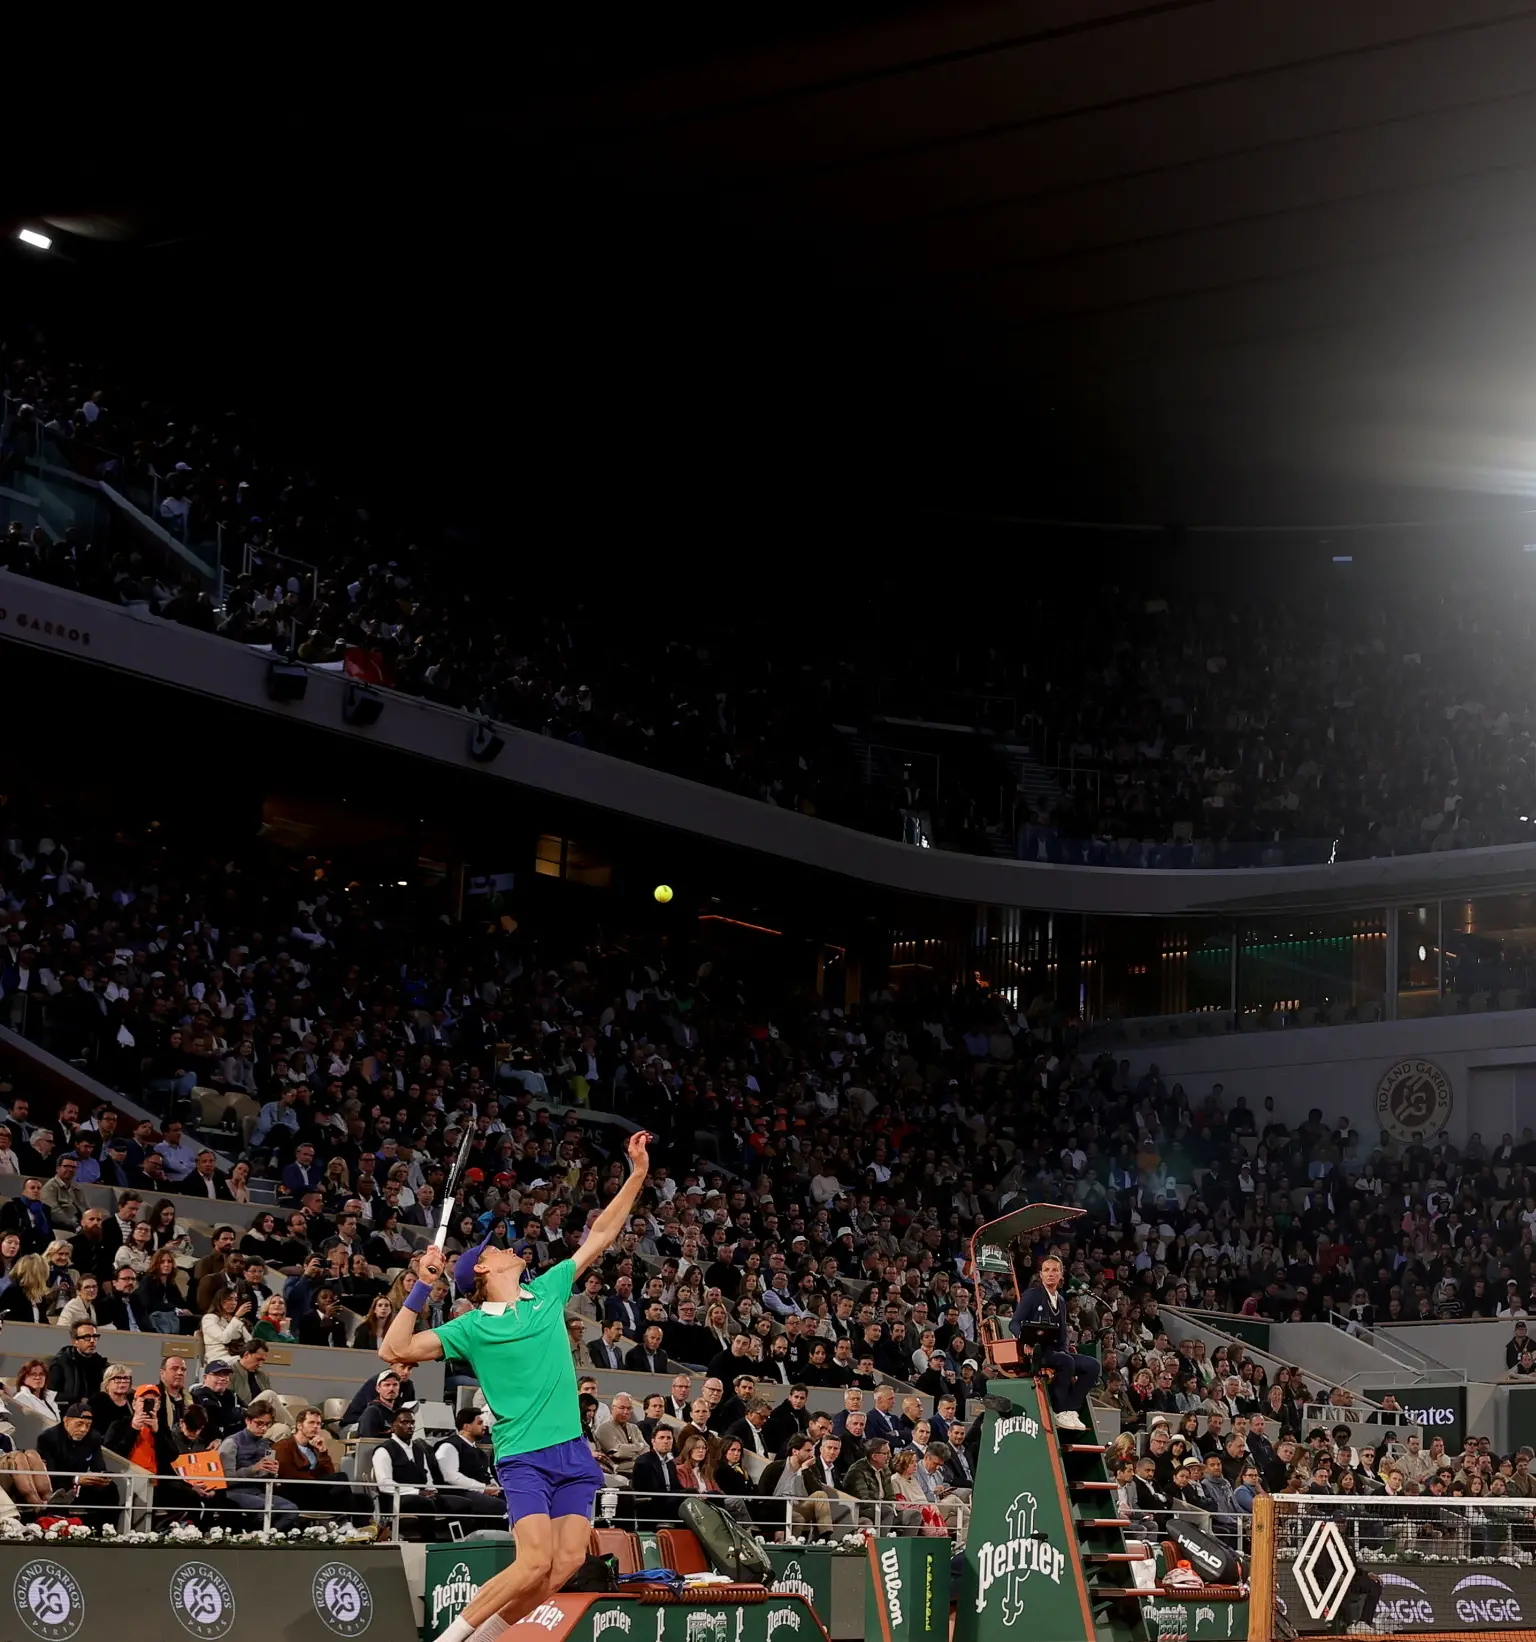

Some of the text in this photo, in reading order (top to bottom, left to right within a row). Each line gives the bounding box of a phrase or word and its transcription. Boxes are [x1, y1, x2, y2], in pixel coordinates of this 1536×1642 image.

[17, 613, 91, 645] GARROS
[1380, 1062, 1448, 1112] ROLAND GARROS
[993, 1412, 1039, 1454] perrier
[1404, 1405, 1455, 1425] irates
[976, 1530, 1065, 1613] perrier
[1177, 1534, 1223, 1569] HEAD
[17, 1564, 81, 1609] ROLAND GARROS
[173, 1566, 232, 1609] ROLAND GARROS
[315, 1566, 370, 1608] ROLAND GARROS
[431, 1575, 481, 1630] perrie
[881, 1547, 904, 1629] Wilson
[32, 1620, 75, 1636] PARIS
[188, 1619, 228, 1635] PARIS
[593, 1605, 633, 1642] perrier
[766, 1605, 801, 1642] perrier
